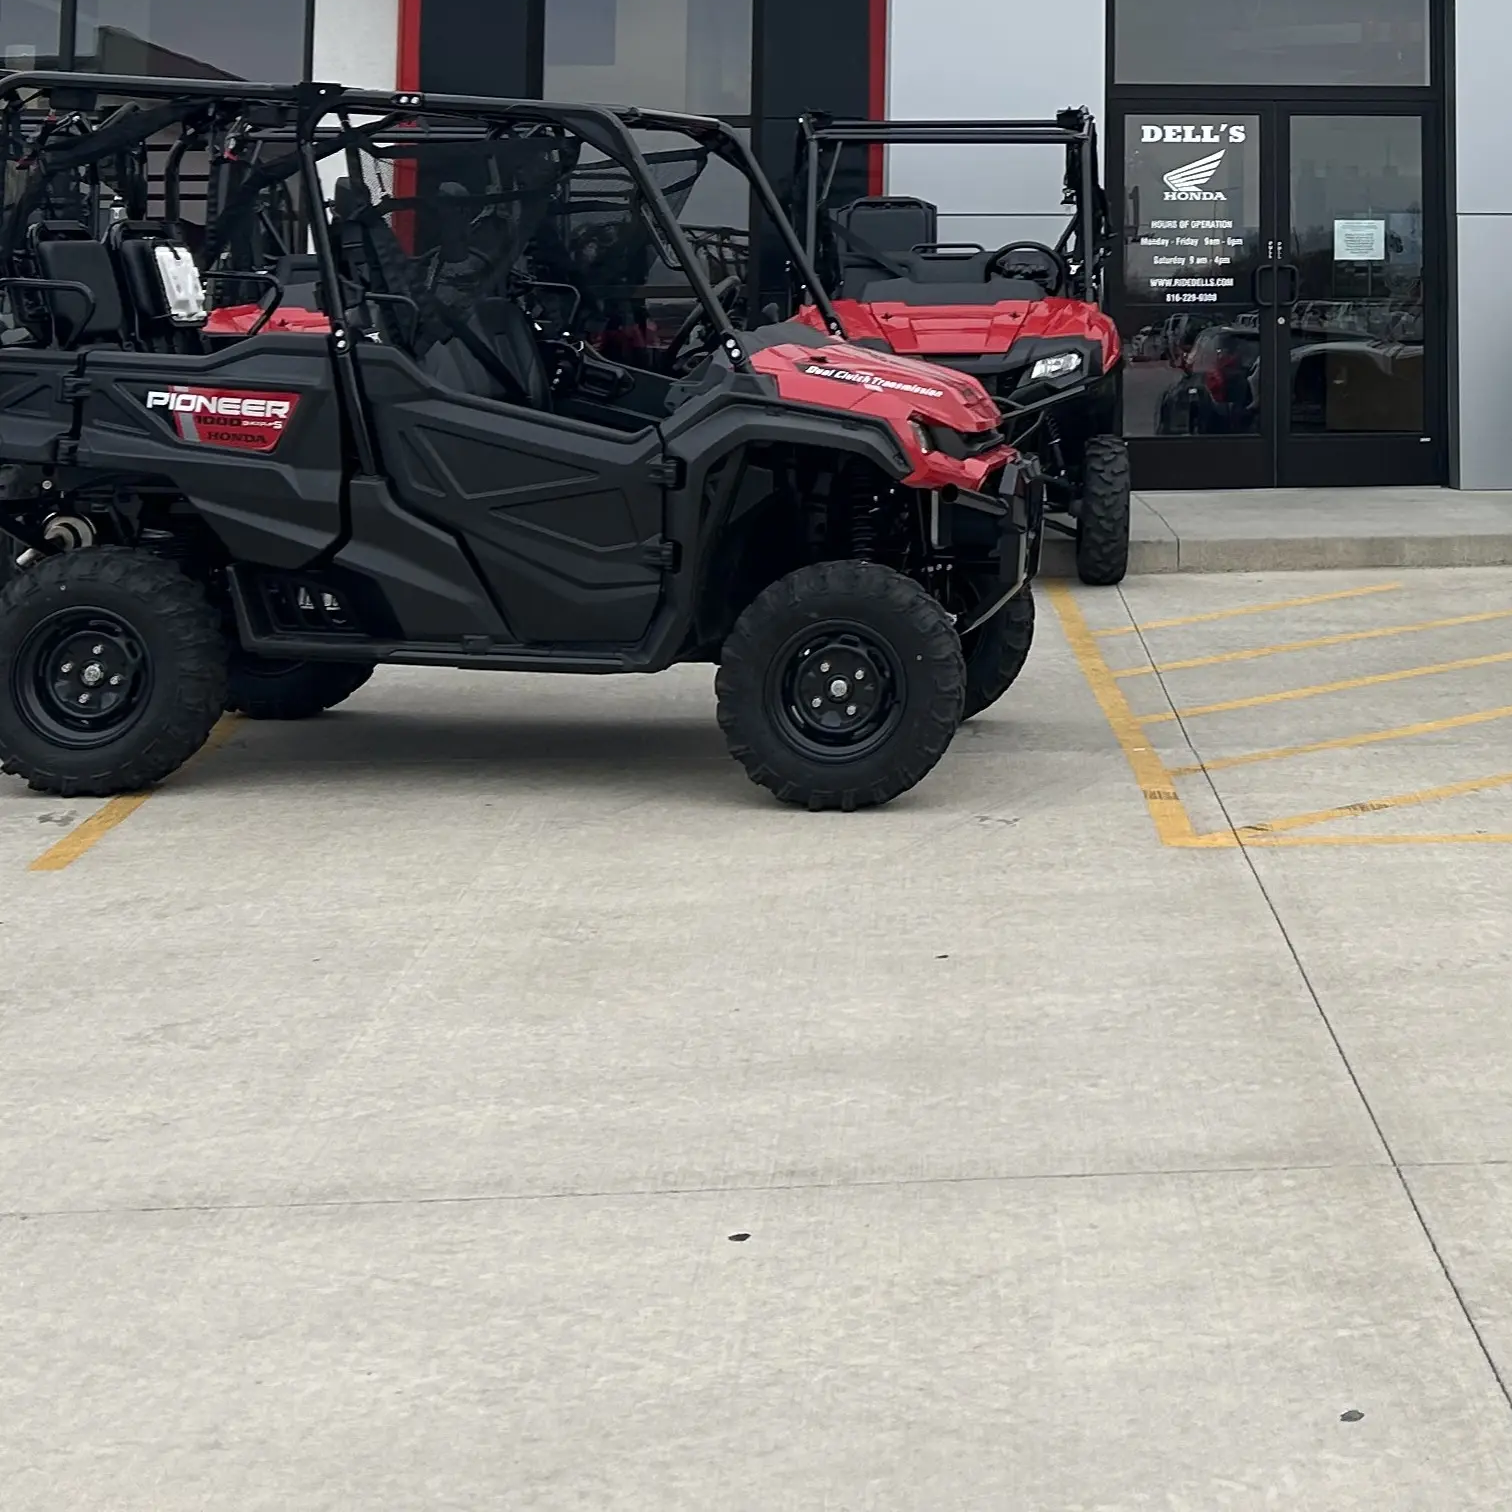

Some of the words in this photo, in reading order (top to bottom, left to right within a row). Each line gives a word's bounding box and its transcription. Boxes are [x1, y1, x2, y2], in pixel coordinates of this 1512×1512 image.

[1140, 123, 1246, 143] DELL'S
[1162, 191, 1228, 201] HONDA
[1151, 220, 1178, 229] HOURS
[1179, 220, 1190, 229] OF
[1190, 220, 1233, 229] OPERATION
[1140, 238, 1169, 246] Monday
[1175, 237, 1199, 247] Friday
[1153, 256, 1186, 265] Saturday
[1213, 256, 1231, 265] 4pm
[1149, 277, 1234, 287] WWW.RIDEDELLS.COM
[805, 365, 834, 377] Dual
[833, 370, 871, 385] Clutch
[870, 376, 944, 398] Transmission
[146, 390, 291, 419] PIONEER
[207, 431, 267, 444] HONDA
